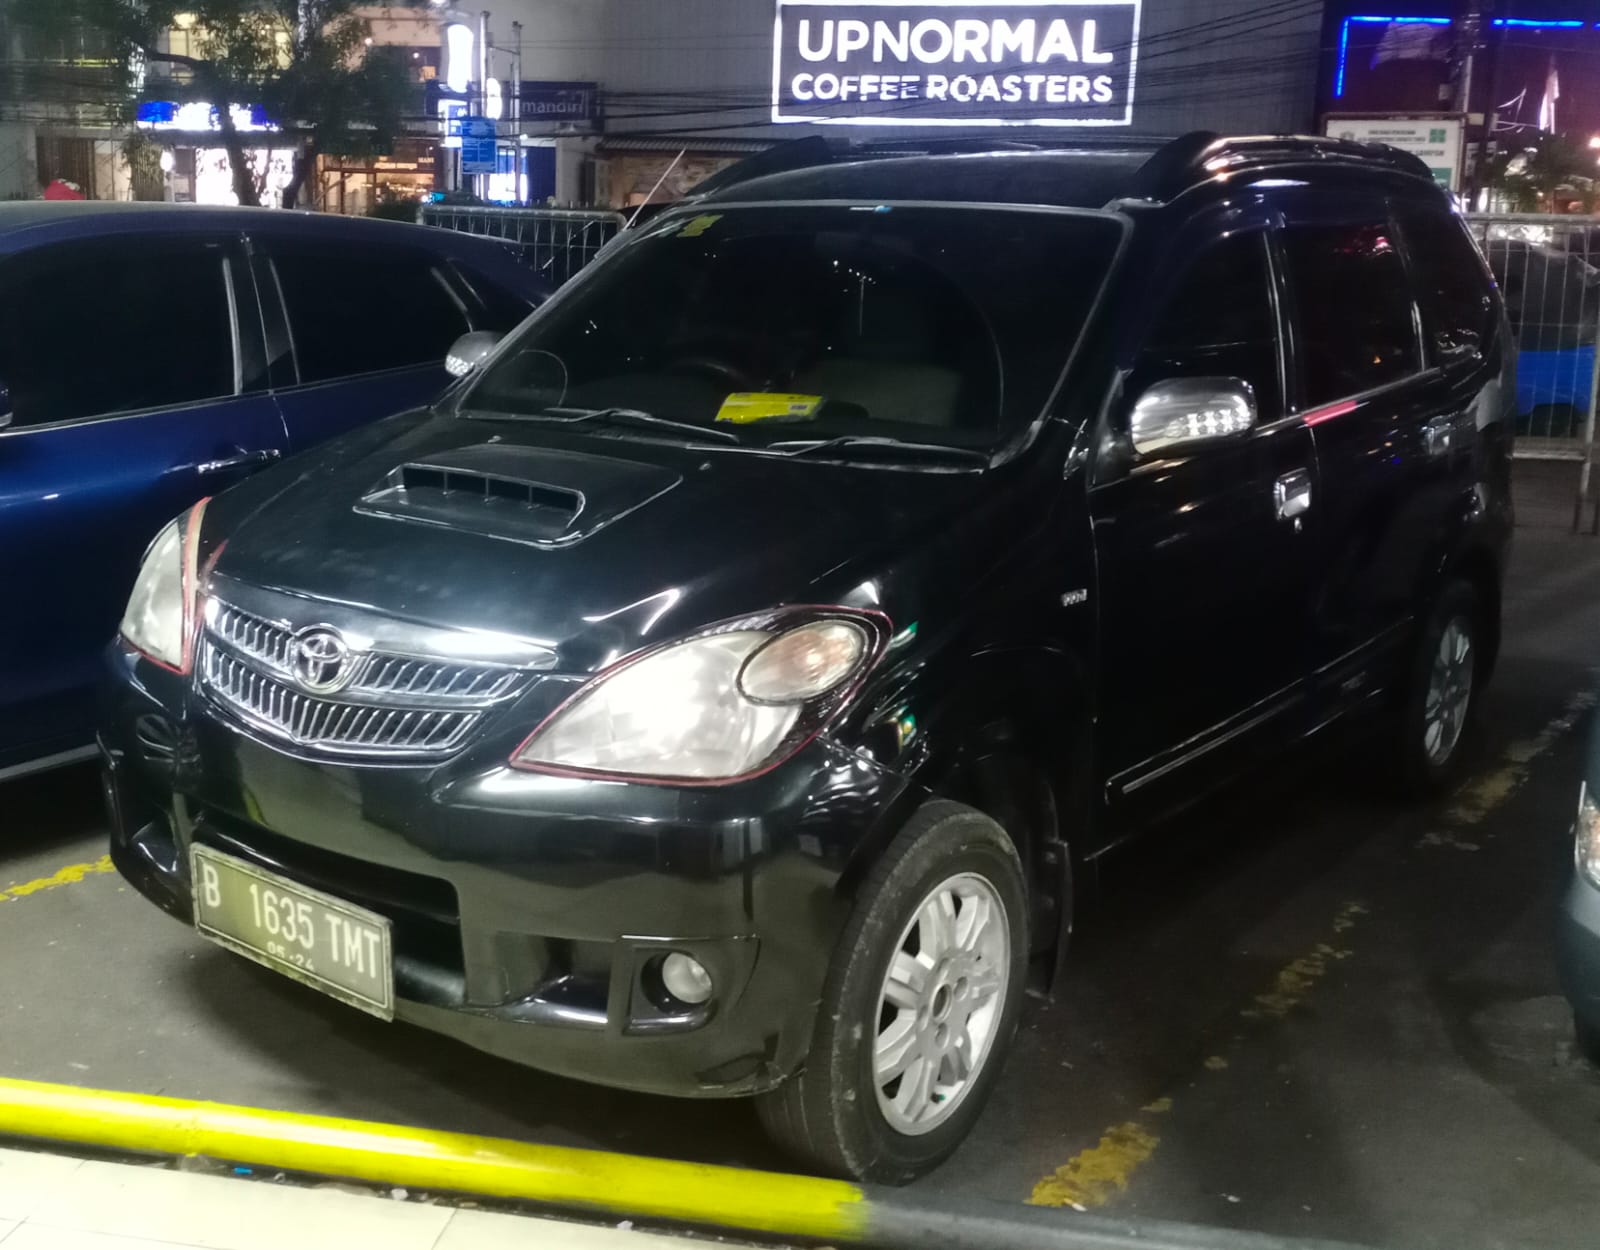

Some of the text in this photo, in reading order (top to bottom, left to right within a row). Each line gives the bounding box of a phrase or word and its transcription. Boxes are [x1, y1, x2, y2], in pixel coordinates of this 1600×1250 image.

[798, 18, 1114, 64] UPNORMAL
[522, 95, 583, 112] mandiri
[791, 73, 1114, 102] COFFEE ROASTERS
[202, 862, 380, 979] B 1635 TMT
